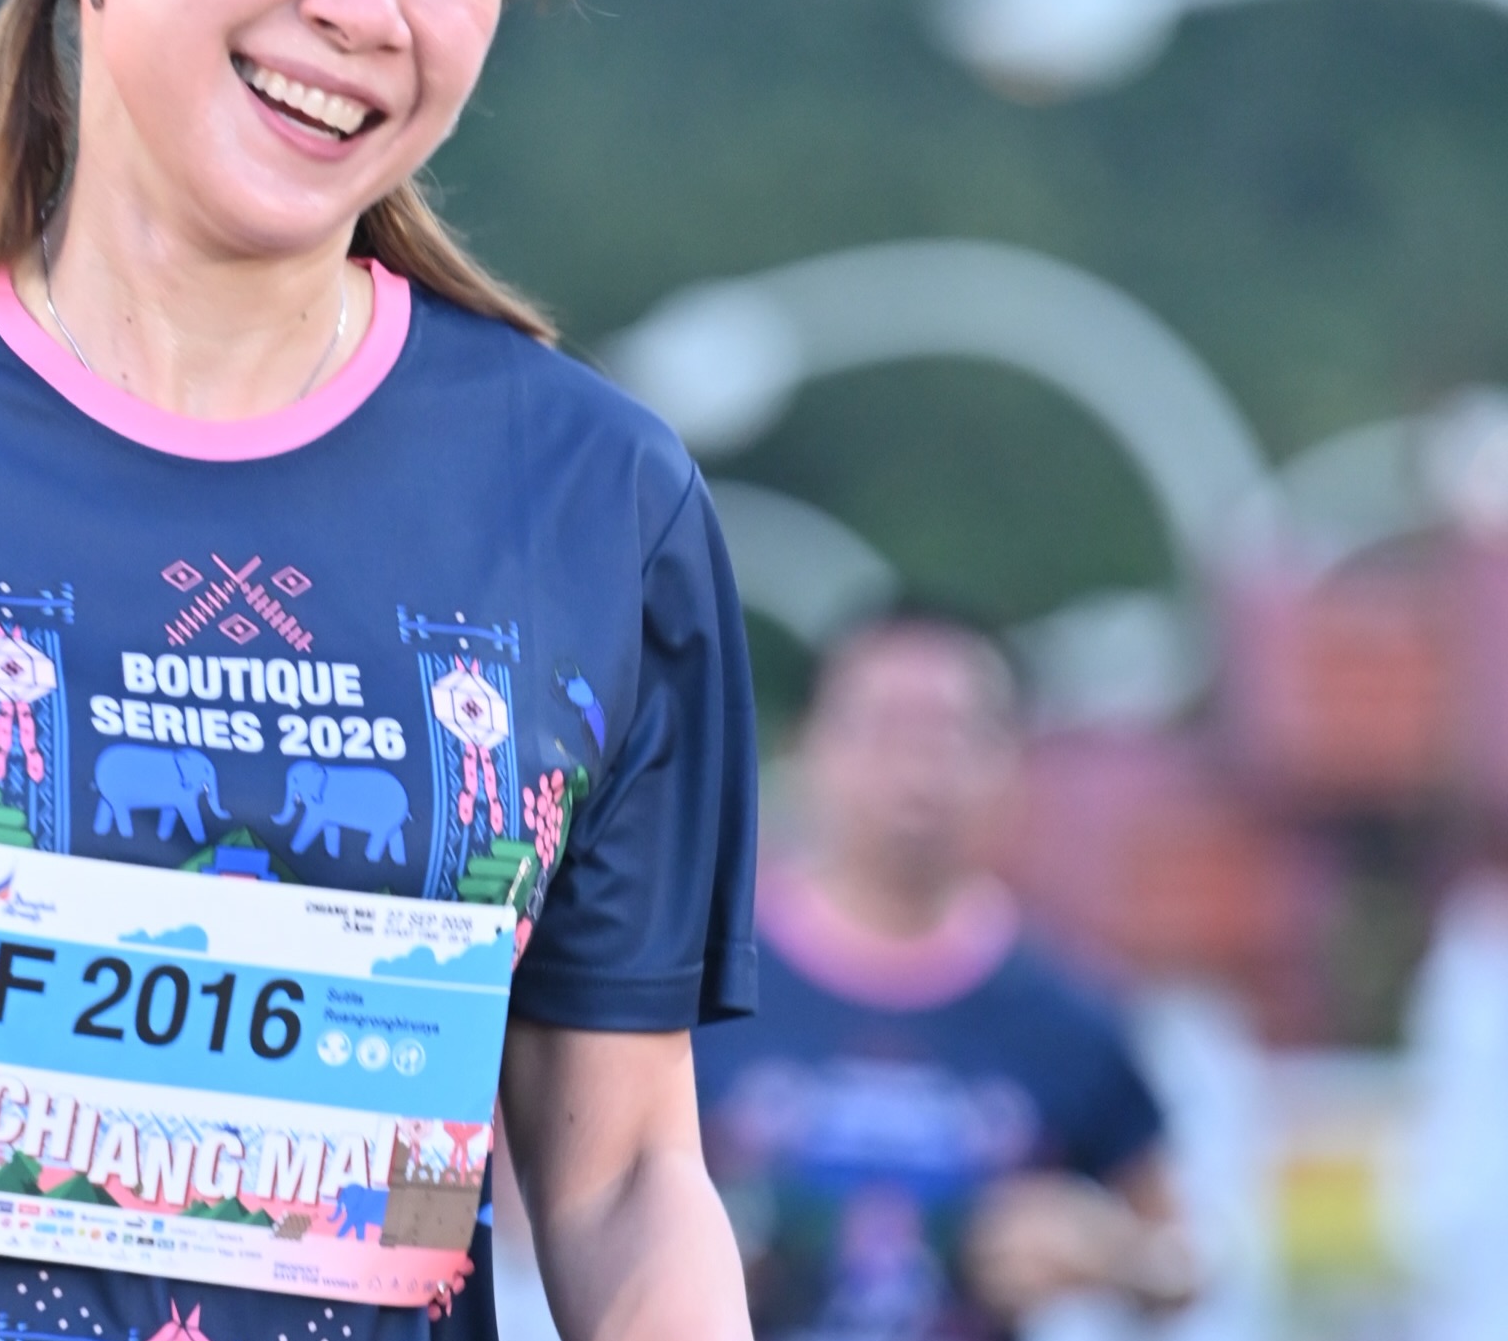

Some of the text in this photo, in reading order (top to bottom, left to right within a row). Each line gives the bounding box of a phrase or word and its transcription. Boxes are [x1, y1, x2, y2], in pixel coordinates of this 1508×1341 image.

[121, 651, 364, 710] BOUTIQUE
[89, 695, 407, 760] SERIES 2026
[73, 956, 304, 1060] 2016
[254, 1114, 397, 1205] MAI
